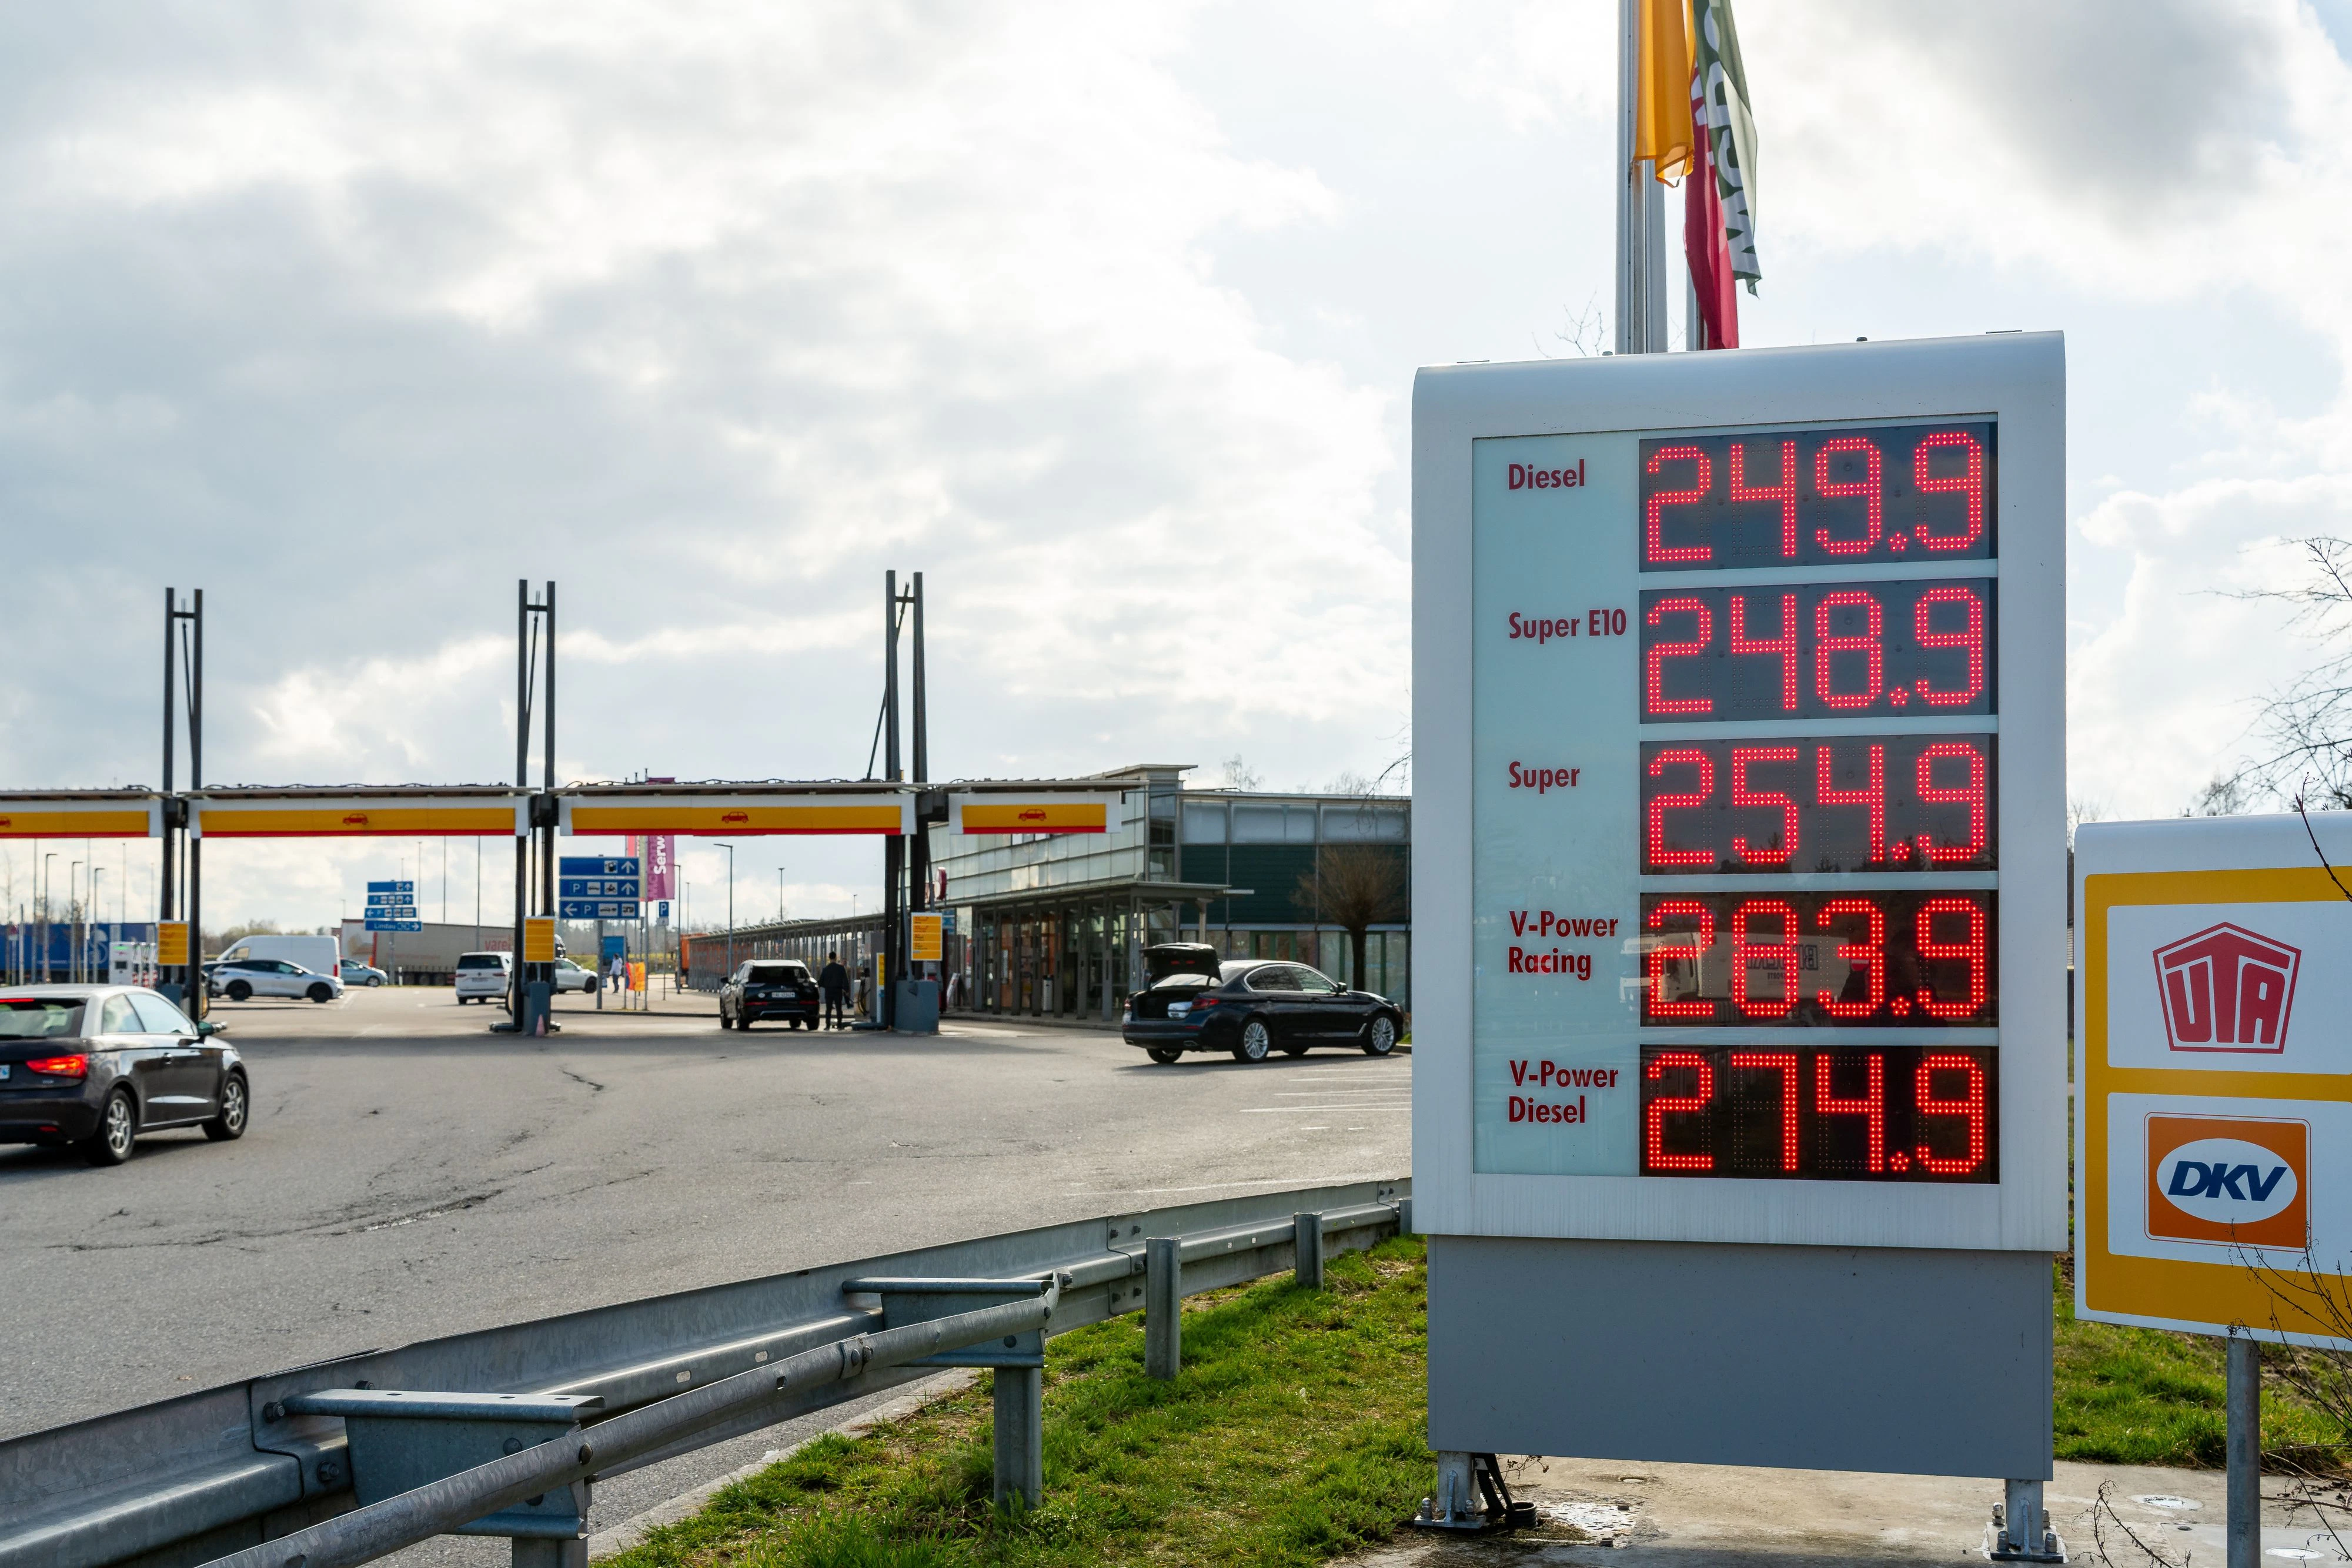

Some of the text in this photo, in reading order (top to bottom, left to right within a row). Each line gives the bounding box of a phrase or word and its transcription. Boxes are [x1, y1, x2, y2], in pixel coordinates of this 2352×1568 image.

[1508, 459, 1585, 490] Diesel
[1647, 432, 1982, 561] 249.9
[1509, 609, 1627, 645] Super E10
[1647, 587, 1983, 714] 248.9
[1509, 761, 1580, 794] Super
[1648, 743, 1984, 865] 254.9
[653, 835, 666, 874] Serw
[1509, 910, 1619, 938] V-Power
[1508, 947, 1592, 981] Racing
[1648, 899, 1984, 1017] 283.9
[2162, 931, 2290, 1044] UTA
[1509, 1059, 1619, 1088] V-Power
[1508, 1095, 1586, 1124] Diesel
[1648, 1054, 1984, 1173] 274.9
[2167, 1161, 2287, 1202] DKV
